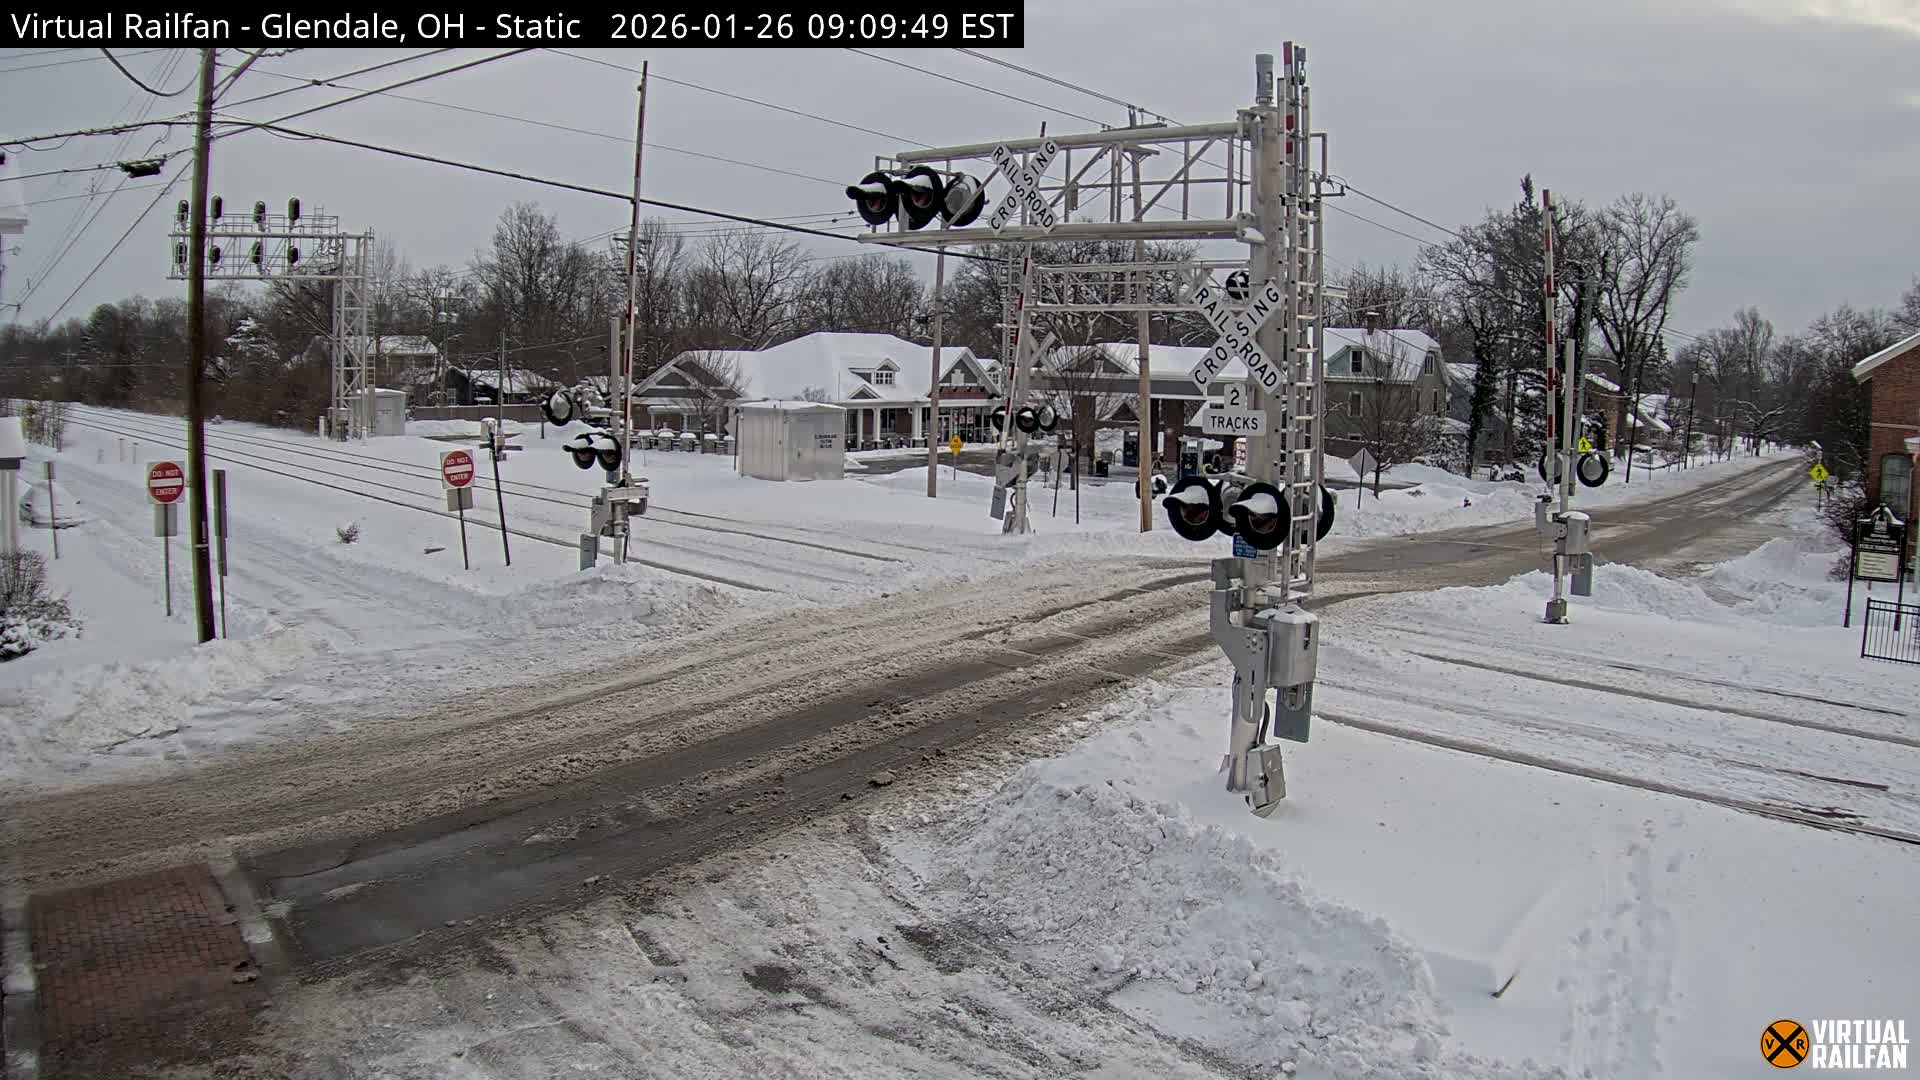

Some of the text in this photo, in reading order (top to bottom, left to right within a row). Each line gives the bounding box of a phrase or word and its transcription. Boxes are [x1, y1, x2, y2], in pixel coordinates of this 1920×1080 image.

[991, 142, 1055, 230] CROSSING
[993, 146, 1054, 228] RAILROAD
[1194, 287, 1280, 385] CROSSING
[1195, 287, 1277, 387] RAILROAD
[1230, 389, 1240, 406] 2
[1210, 415, 1258, 430] TRACKS
[152, 470, 161, 478] DO
[451, 473, 468, 481] ENTER
[155, 488, 177, 496] ENTER
